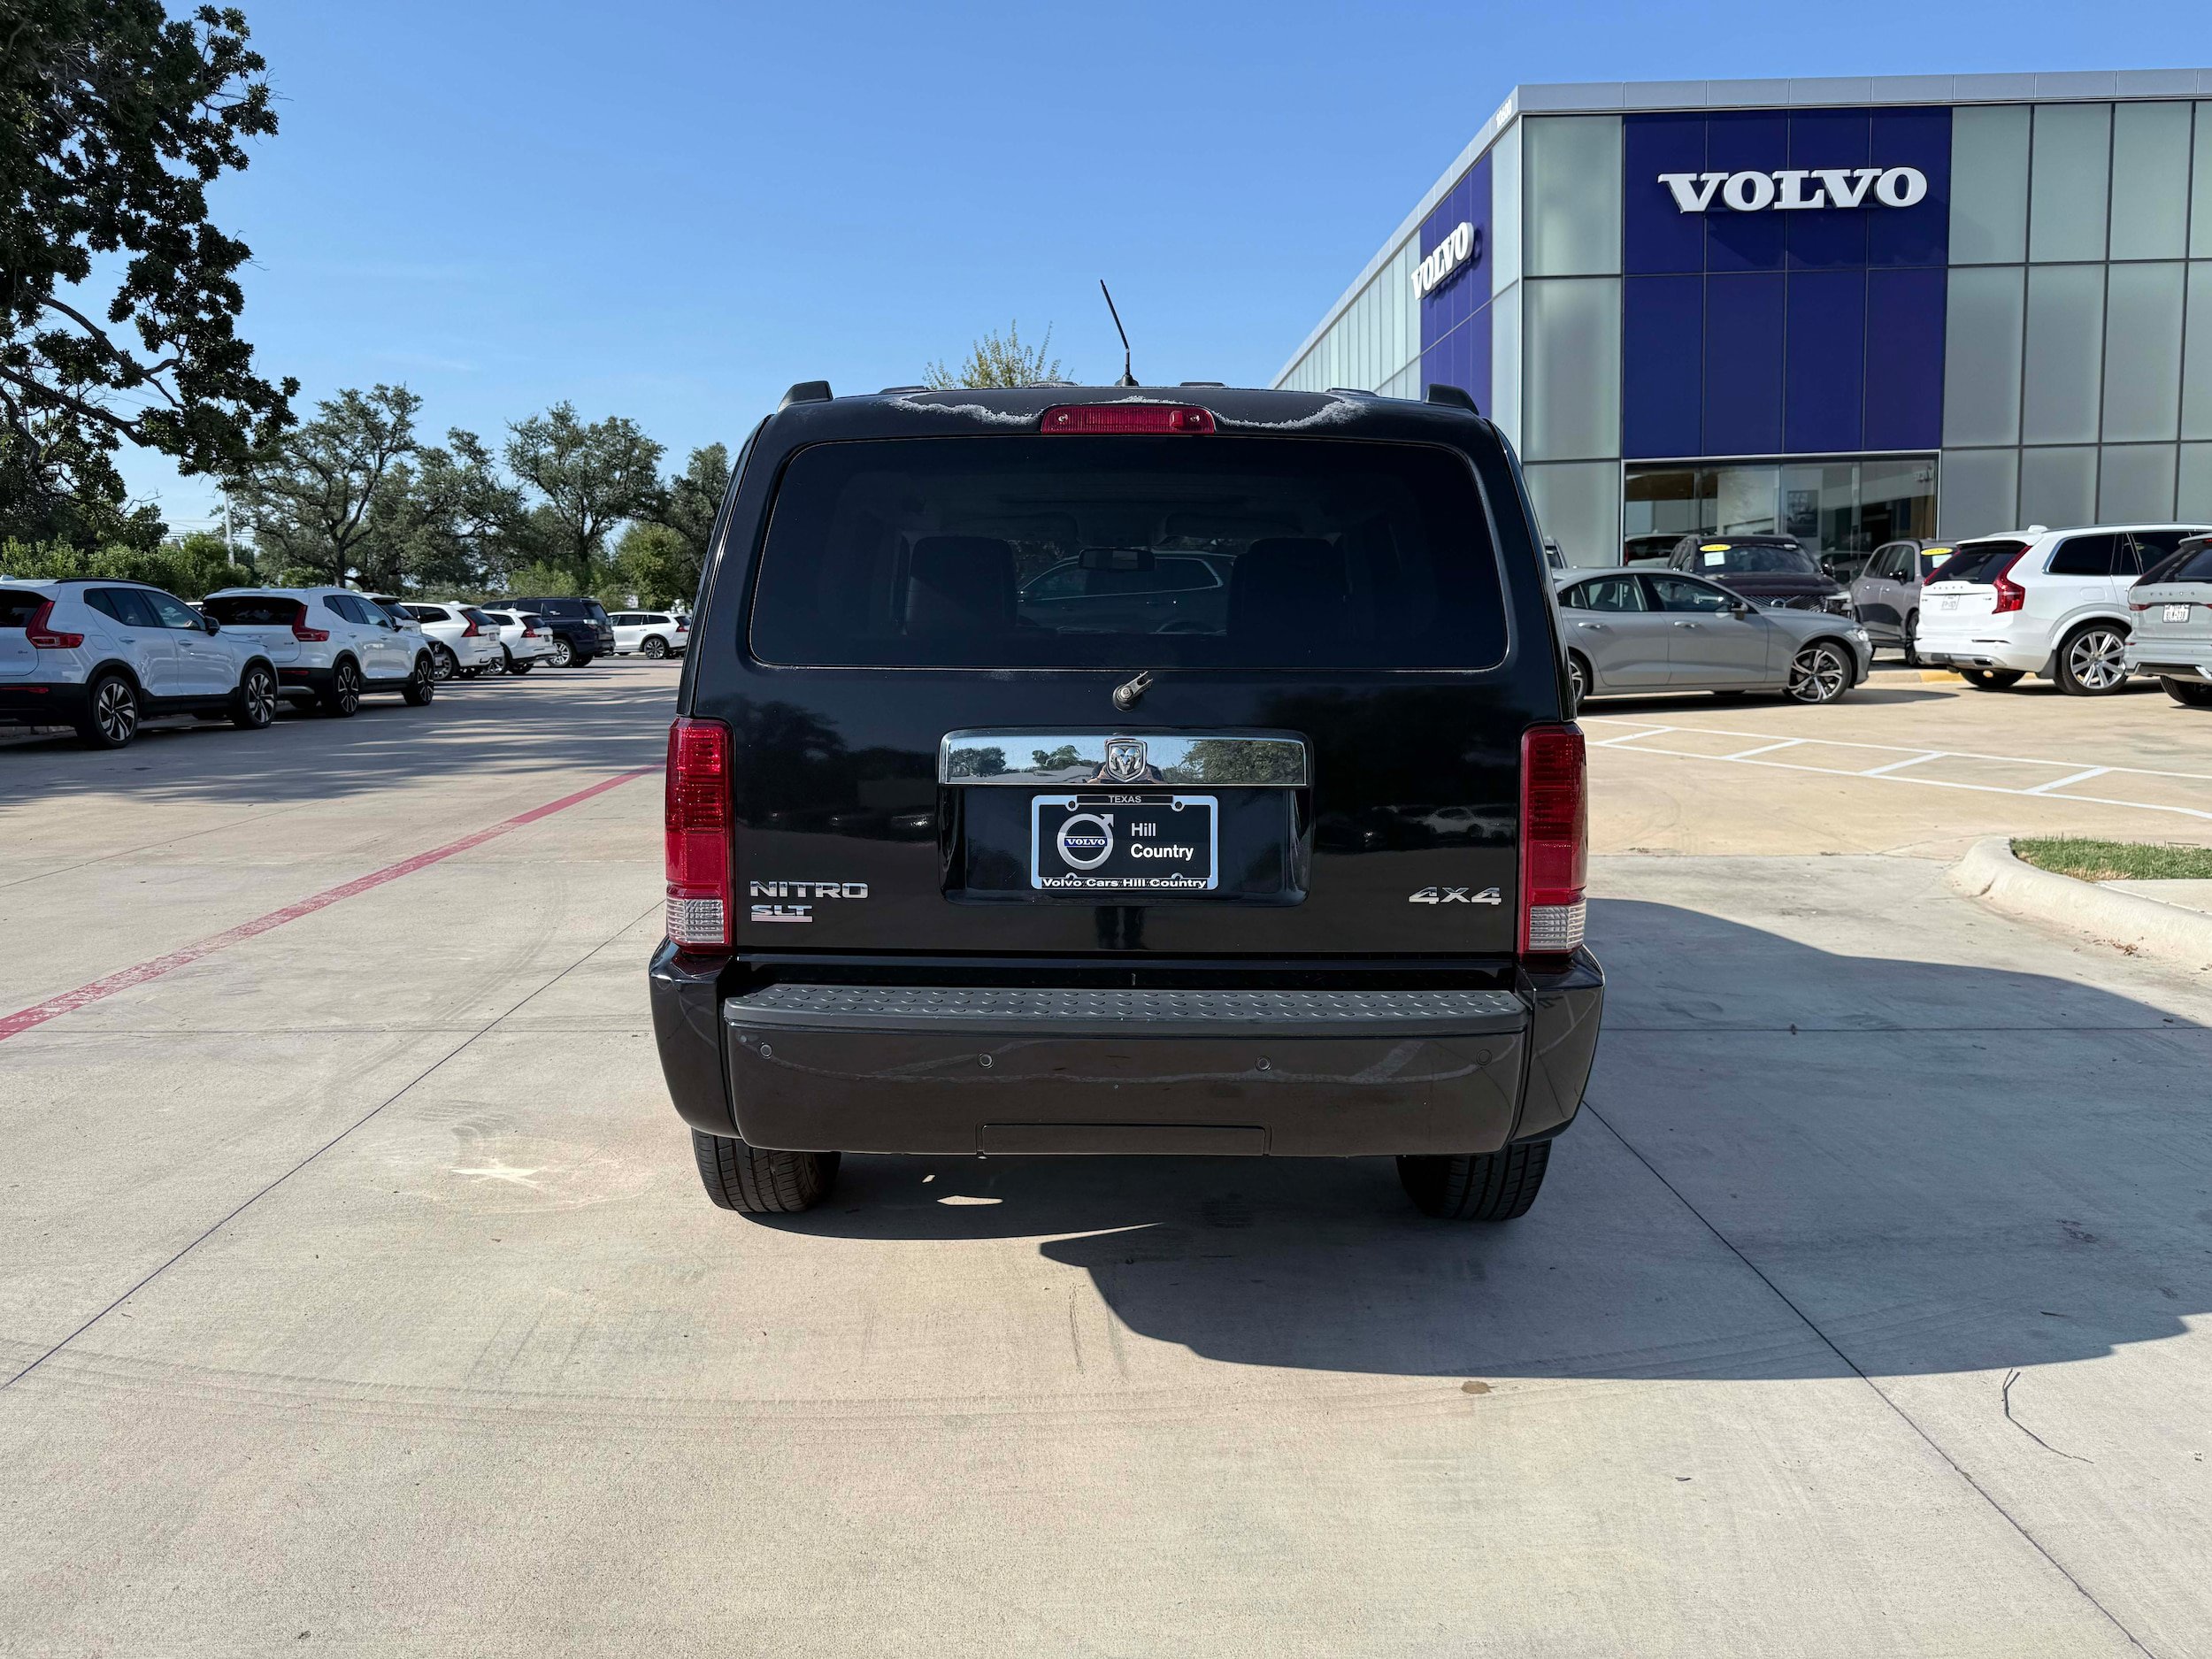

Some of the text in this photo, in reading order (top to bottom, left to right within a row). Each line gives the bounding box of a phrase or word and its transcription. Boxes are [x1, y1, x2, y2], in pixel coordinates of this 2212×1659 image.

[1657, 166, 1927, 213] VOLVO
[1410, 221, 1475, 301] VOLVO
[1131, 823, 1156, 837] Hill
[1130, 843, 1194, 861] Country
[749, 880, 869, 898] NITRO
[1149, 879, 1207, 889] Country
[750, 904, 813, 917] SLT
